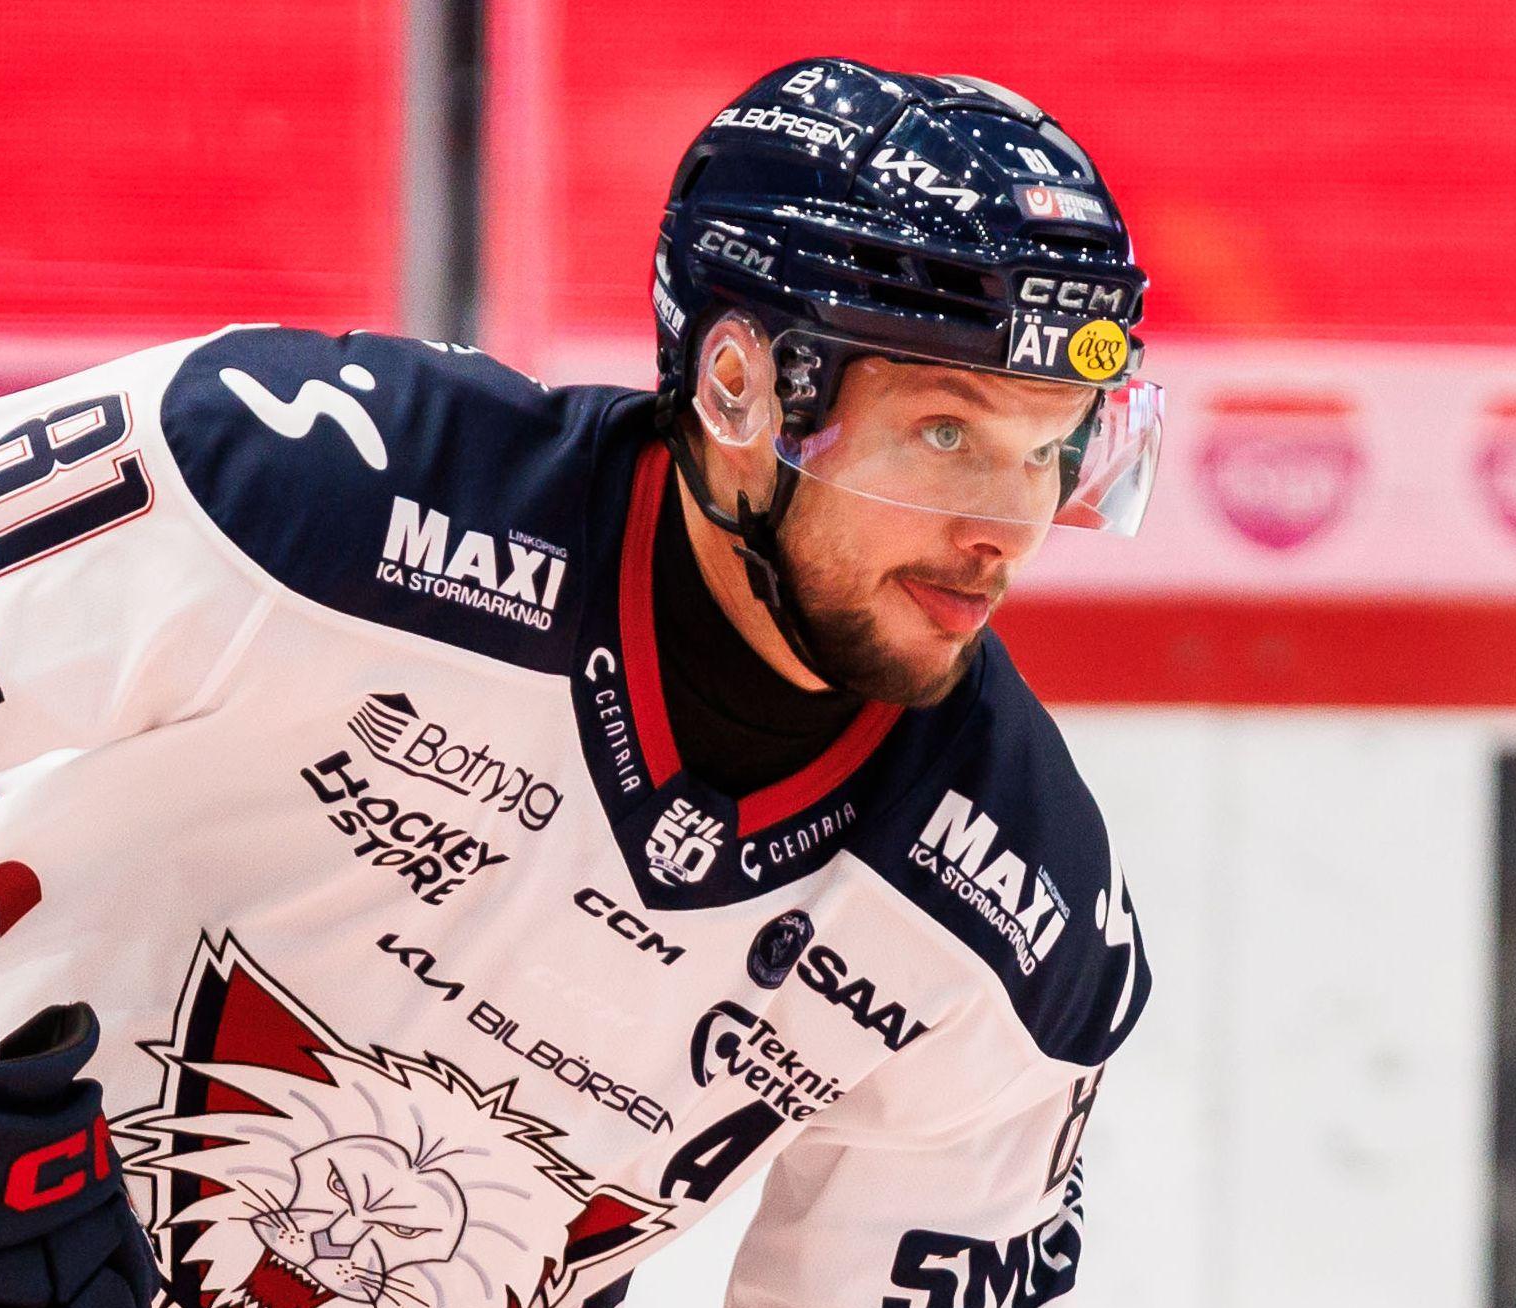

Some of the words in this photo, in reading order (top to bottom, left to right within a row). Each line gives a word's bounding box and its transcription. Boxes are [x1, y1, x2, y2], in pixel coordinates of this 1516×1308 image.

[1016, 147, 1060, 176] 81
[699, 230, 775, 274] CCM
[1020, 277, 1123, 313] CCM
[1012, 314, 1069, 367] ÄT
[1077, 330, 1122, 371] ägg
[376, 560, 405, 587] ICA
[408, 572, 553, 632] STORMARKNAD
[382, 495, 568, 610] MAXI
[403, 723, 565, 832] Botrygg
[595, 689, 641, 793] CENTRIA
[300, 751, 511, 876] HOCKEY
[664, 798, 725, 847] SHL
[769, 802, 857, 864] CENTRIA
[328, 811, 465, 906] STORE
[918, 788, 1067, 963] MAXI
[573, 887, 688, 966] CCM
[940, 865, 1037, 977] STORMARKNAD
[659, 1098, 787, 1203] A
